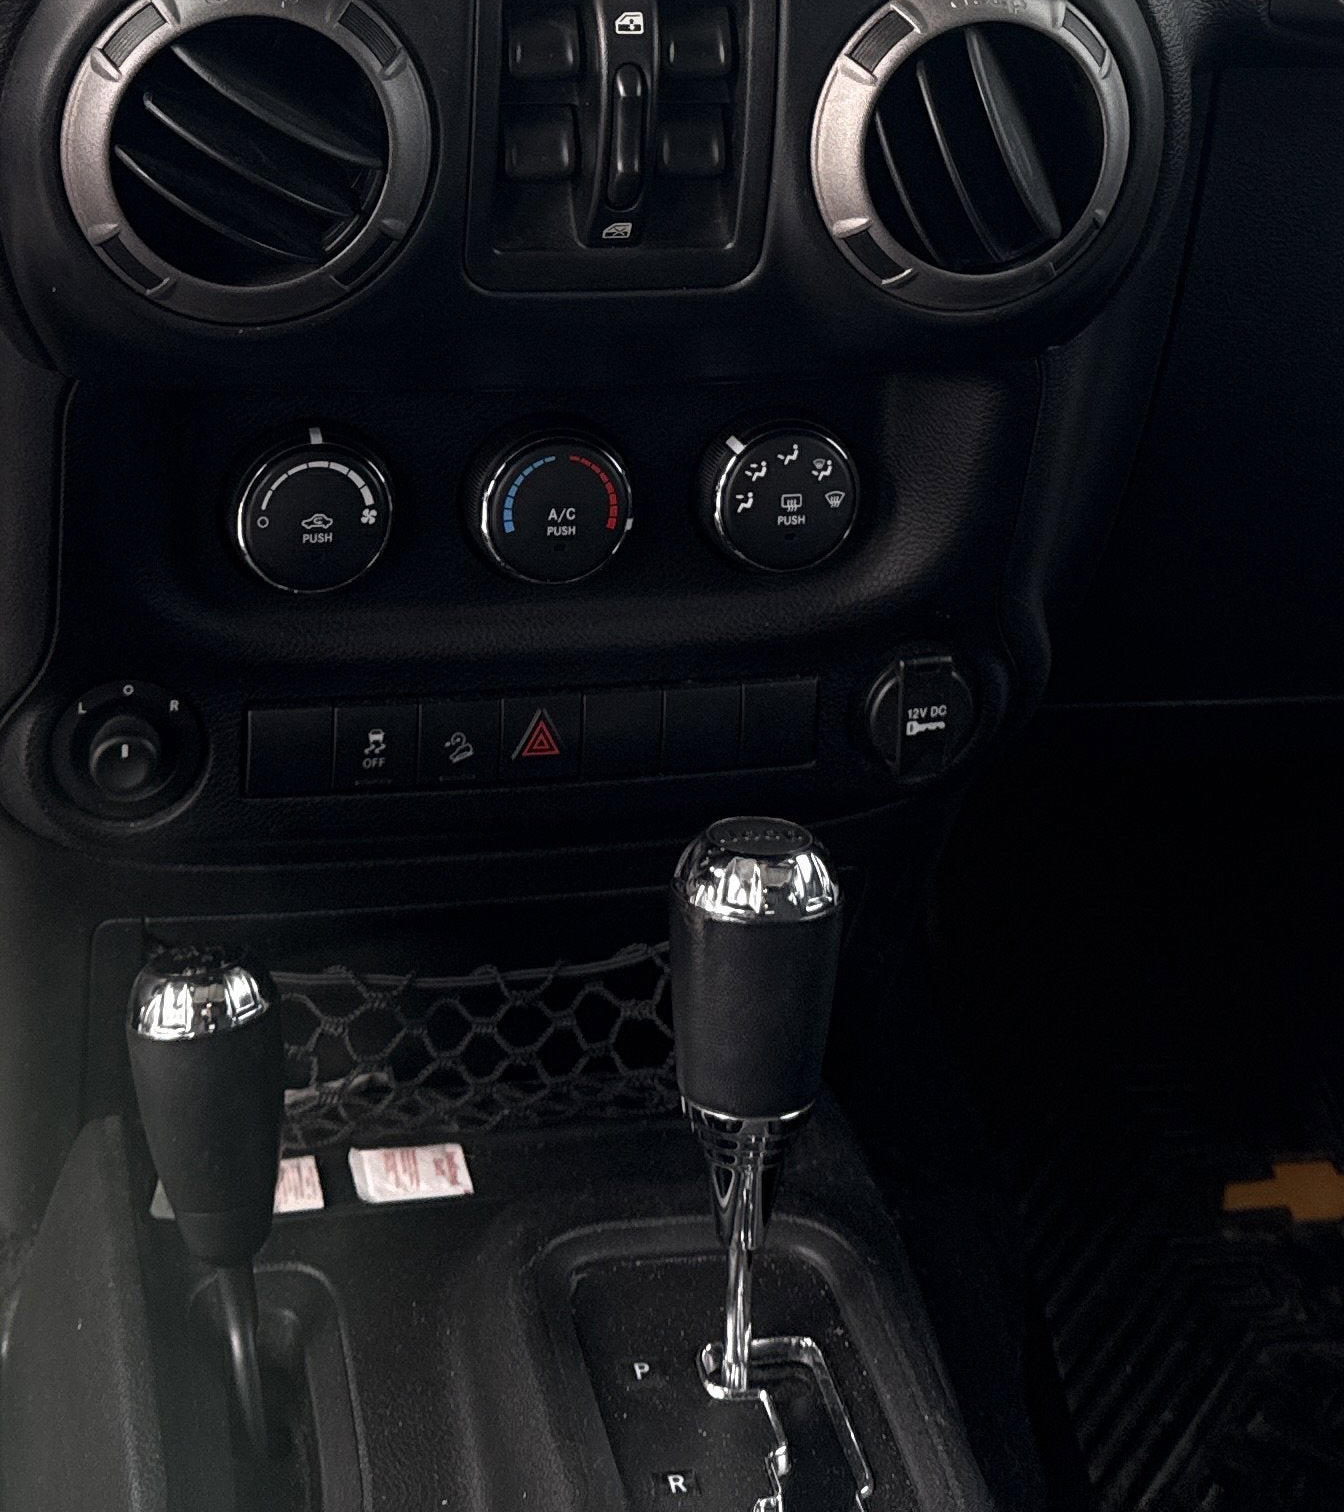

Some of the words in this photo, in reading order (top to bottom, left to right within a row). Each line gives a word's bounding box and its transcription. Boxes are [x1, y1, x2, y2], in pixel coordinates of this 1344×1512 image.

[547, 507, 576, 522] A/C
[777, 514, 805, 526] PUSH
[546, 525, 576, 537] PUSH
[302, 532, 333, 544] PUSH
[907, 707, 927, 719] 12V
[930, 705, 947, 717] DC
[362, 757, 385, 770] OFF
[634, 1362, 650, 1380] P
[667, 1474, 687, 1494] R
